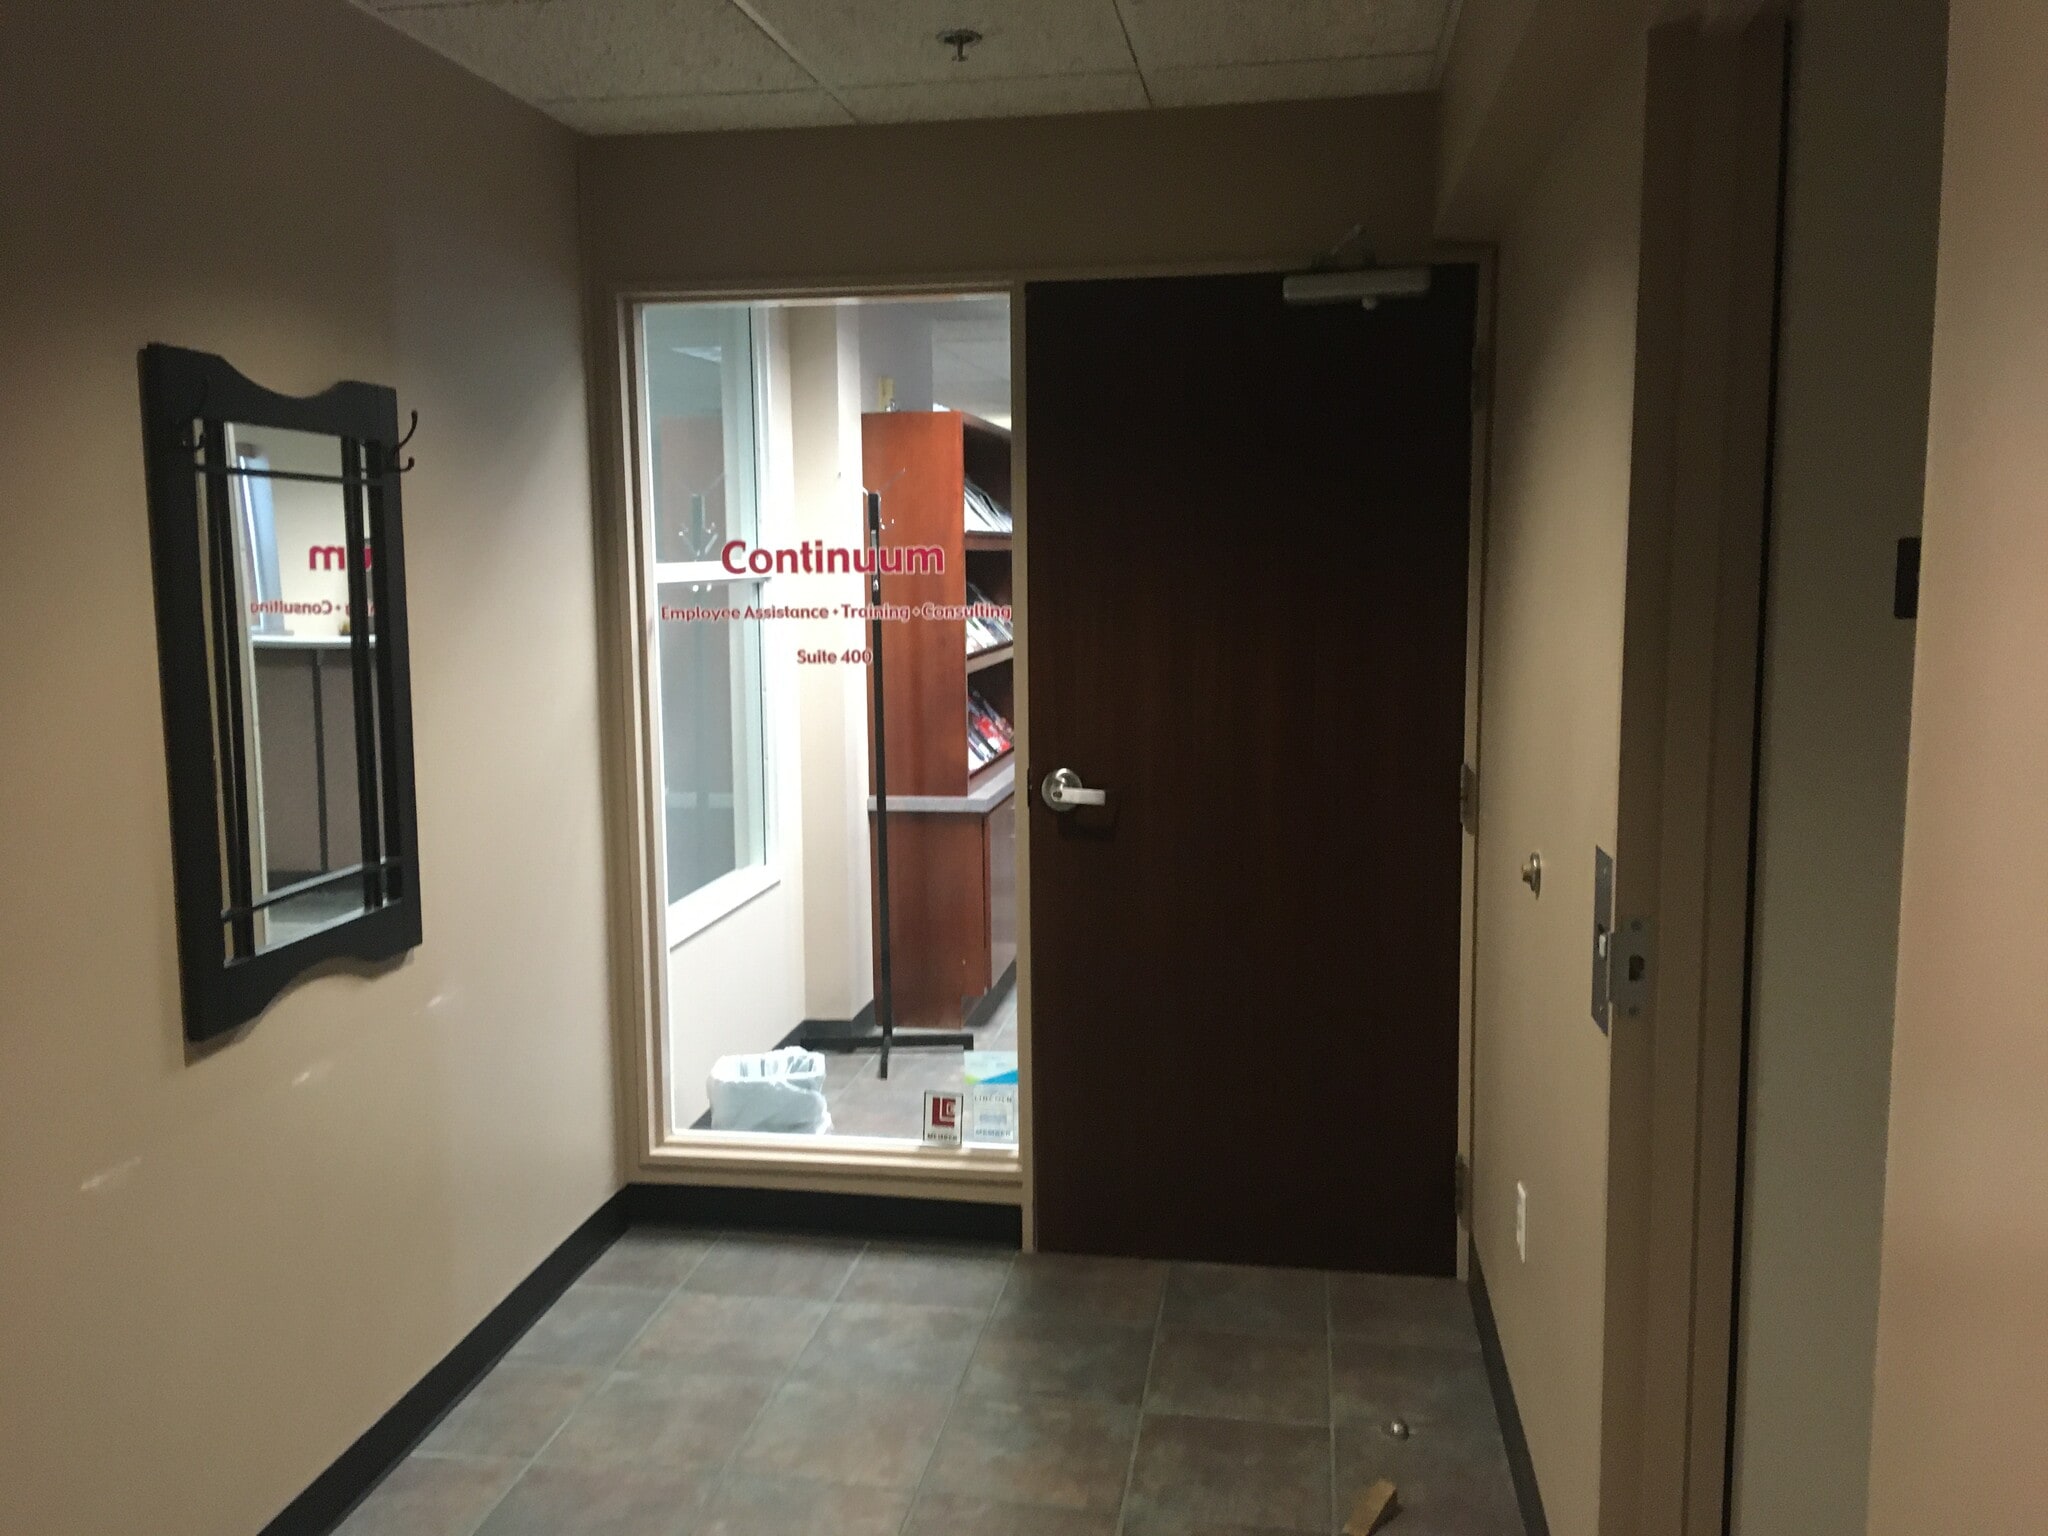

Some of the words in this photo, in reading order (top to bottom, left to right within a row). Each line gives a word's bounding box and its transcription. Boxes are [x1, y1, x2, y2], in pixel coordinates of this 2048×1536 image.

[722, 540, 945, 575] Continuum
[661, 604, 739, 623] Employee
[744, 604, 828, 620] Assistance
[841, 603, 910, 622] Training
[923, 602, 1012, 622] Consulting
[797, 649, 837, 664] Suite
[841, 649, 873, 665] 400
